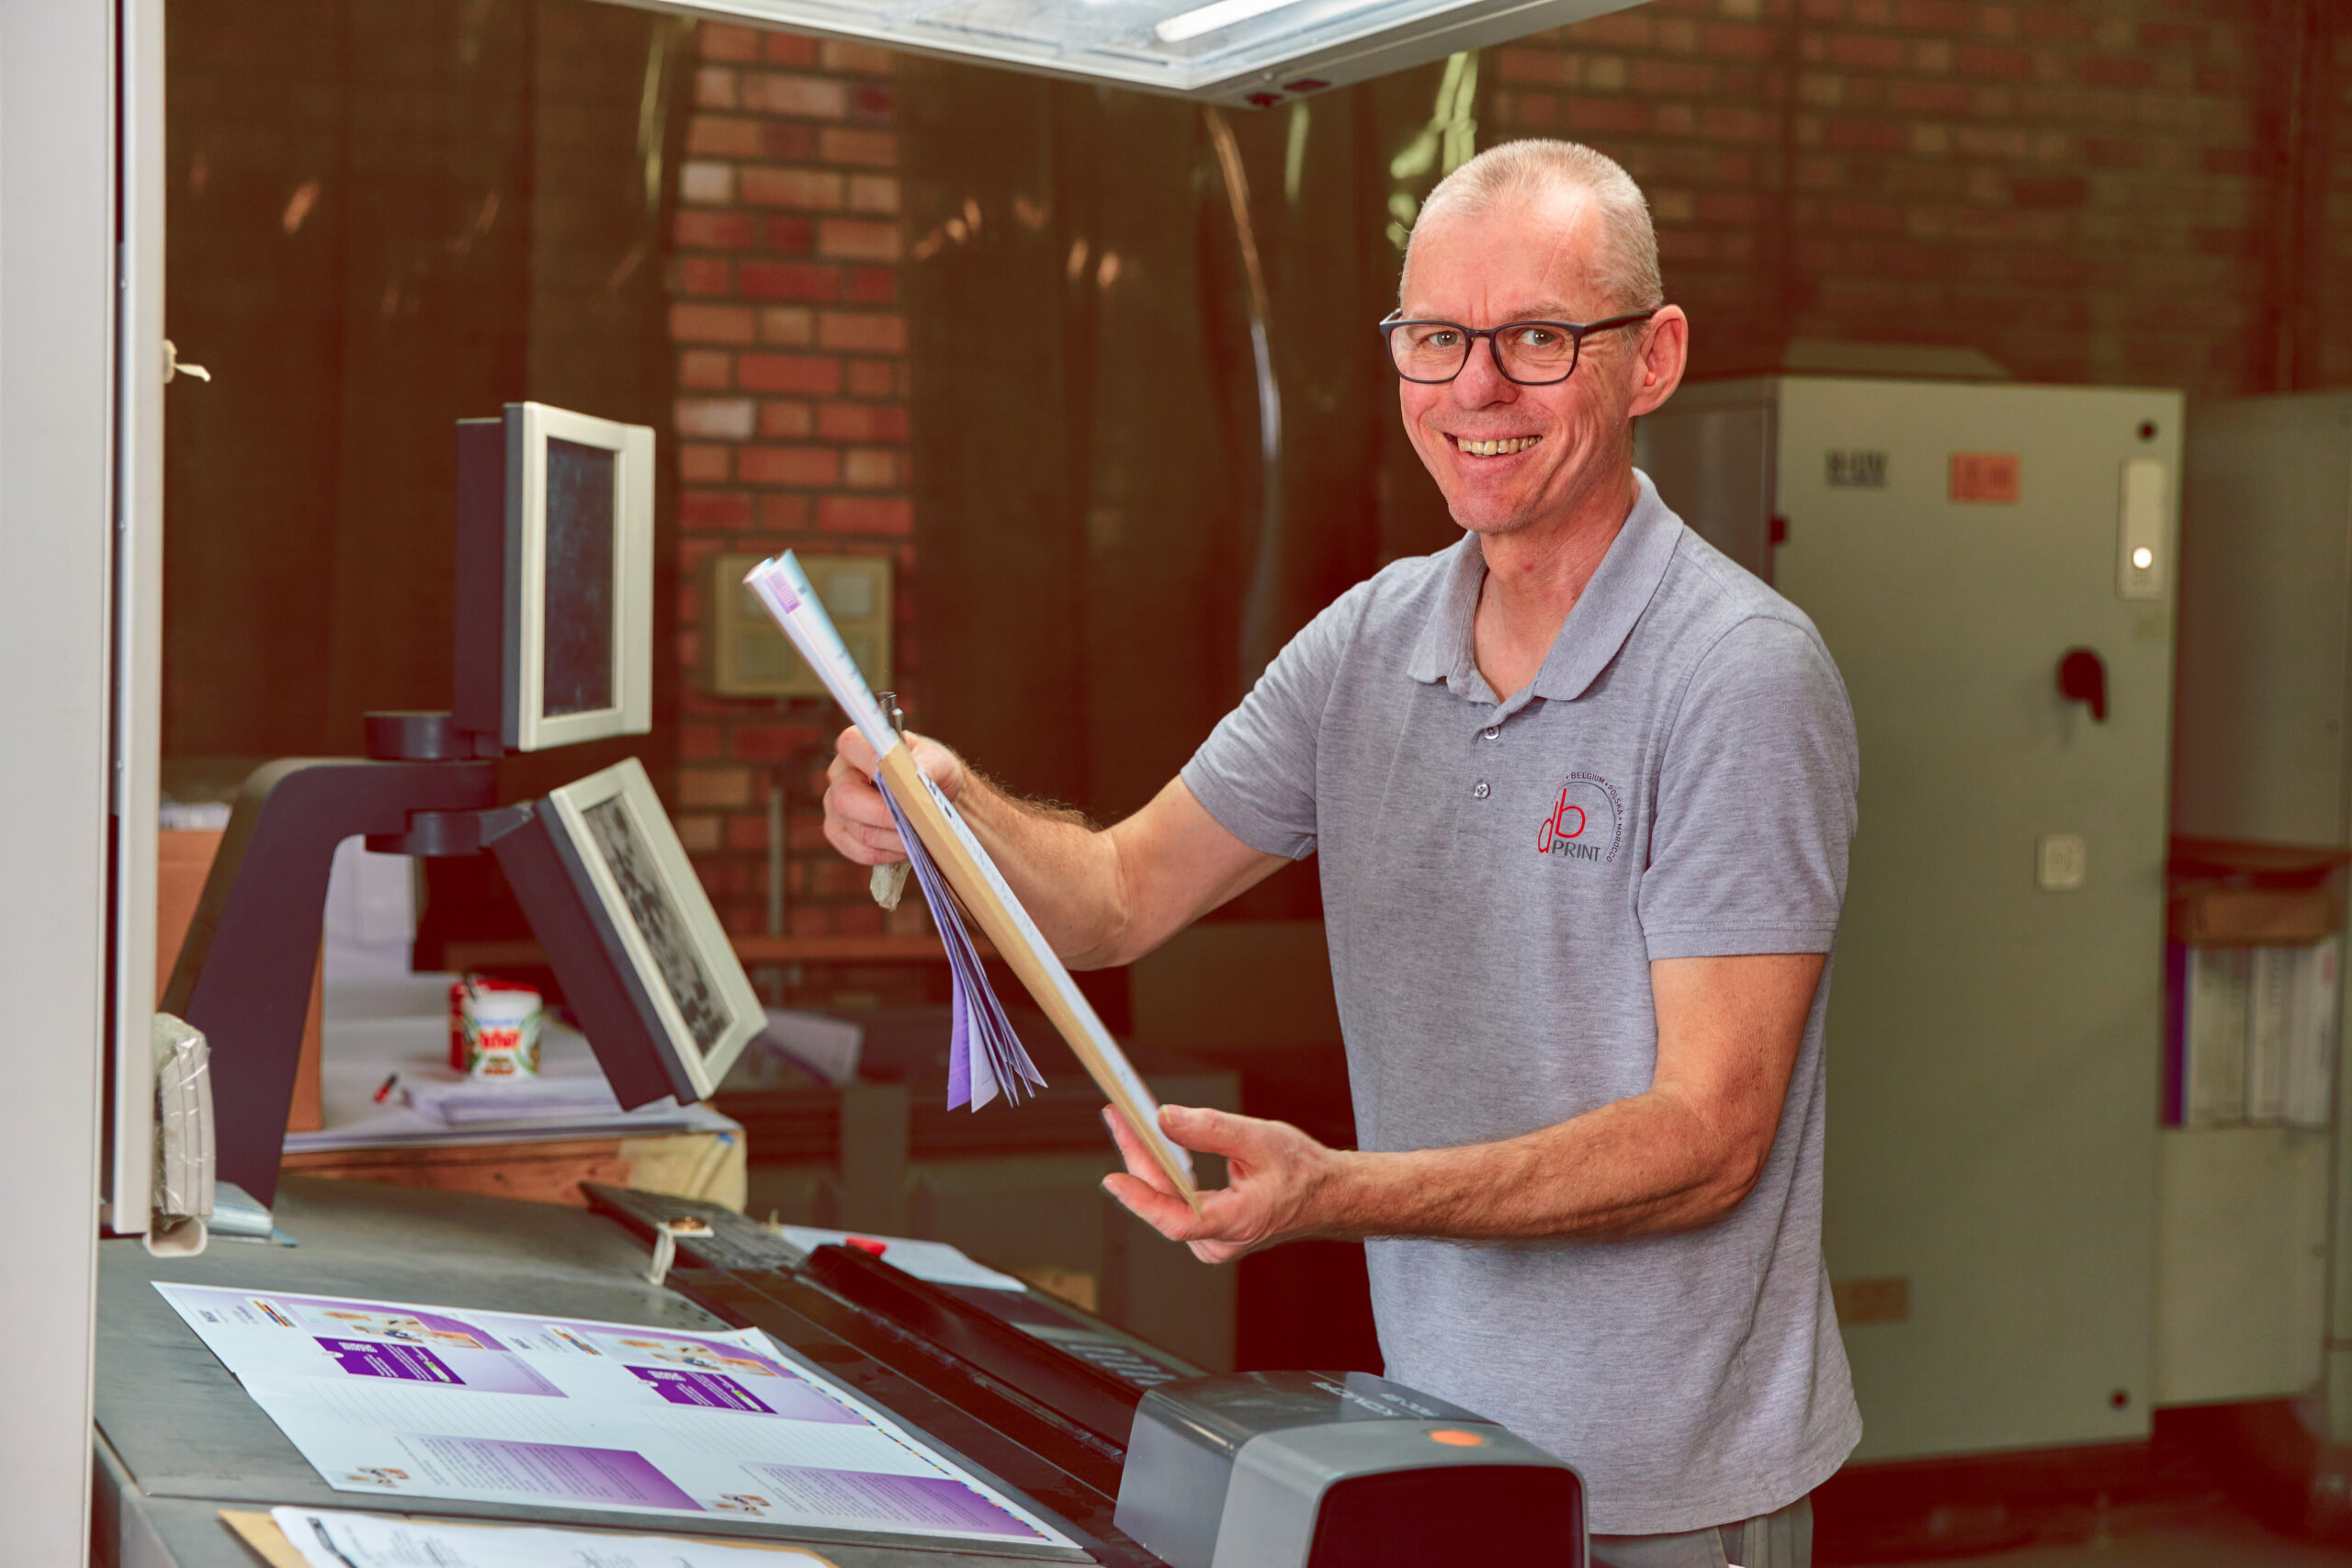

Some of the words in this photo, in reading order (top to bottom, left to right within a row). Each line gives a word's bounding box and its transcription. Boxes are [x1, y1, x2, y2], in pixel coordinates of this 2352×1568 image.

[1570, 773, 1605, 784] BELGIUM
[1608, 785, 1623, 815] POLSKA
[1552, 840, 1600, 862] PRINT
[1606, 824, 1622, 863] MOROCCO
